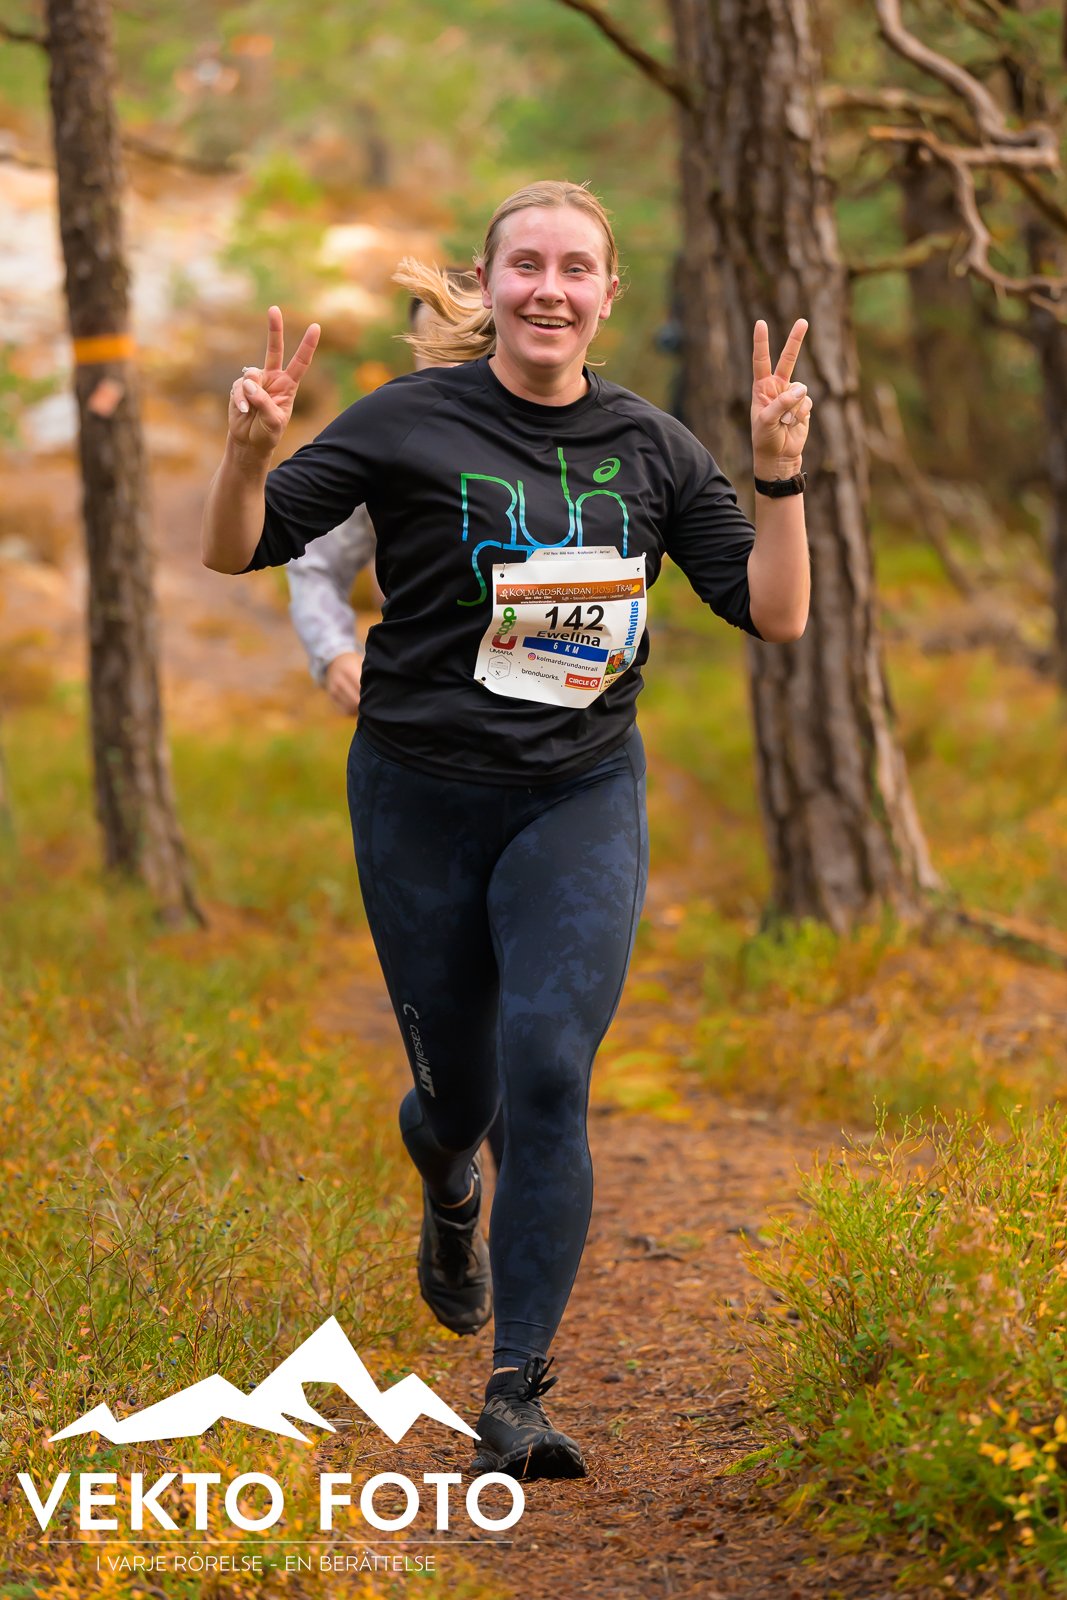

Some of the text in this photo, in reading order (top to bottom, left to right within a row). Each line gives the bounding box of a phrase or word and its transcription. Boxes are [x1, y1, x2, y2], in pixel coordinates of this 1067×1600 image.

[545, 605, 605, 632] 142
[624, 600, 639, 646] Aktivitus
[536, 629, 601, 648] Ewelina
[489, 648, 514, 656] UMARA
[553, 642, 558, 650] 6
[568, 677, 590, 686] CIRCLE
